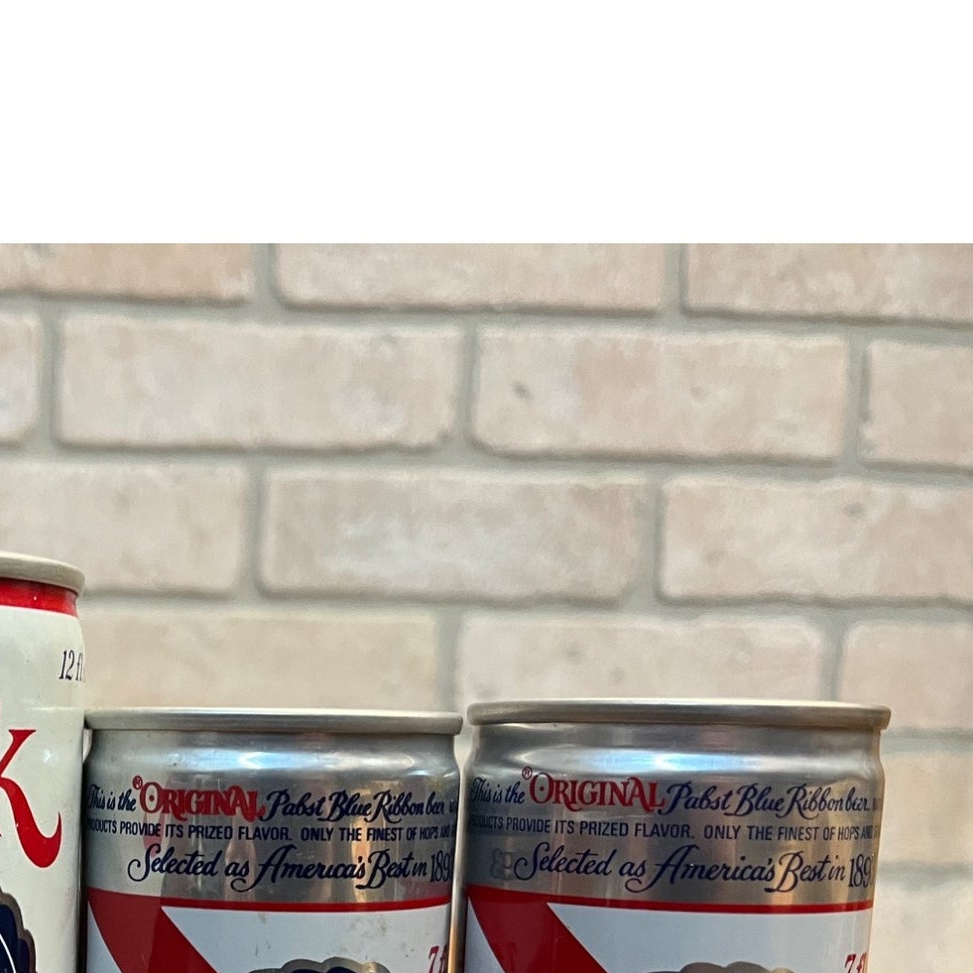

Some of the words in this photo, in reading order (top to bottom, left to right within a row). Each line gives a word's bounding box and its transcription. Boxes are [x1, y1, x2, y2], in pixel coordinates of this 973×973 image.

[58, 649, 75, 681] 12
[107, 791, 116, 811] is
[118, 788, 137, 812] the
[139, 781, 266, 823] ORIGINAL
[259, 788, 327, 822] Pabst
[317, 789, 372, 822] Blue
[364, 789, 425, 823] Ribbon
[471, 776, 491, 803] This
[492, 783, 502, 803] is
[504, 780, 526, 805] the
[529, 772, 666, 813] ORIGINAL
[657, 780, 734, 816] Pabst
[723, 782, 785, 817] Blue
[775, 783, 845, 820] Ribbon
[120, 822, 162, 837] PROVIDE
[165, 824, 184, 838] ITS
[188, 825, 233, 840] PRIZED
[238, 826, 292, 842] FLAVOR.
[300, 827, 334, 842] ONLY
[339, 827, 363, 842] THE
[366, 826, 403, 842] FINEST
[406, 826, 418, 840] OF
[420, 826, 439, 840] HOPS
[506, 818, 551, 833] PROVIDE
[555, 819, 575, 834] ITS
[579, 820, 629, 837] PRIZED
[634, 822, 695, 839] FLAVOR.
[703, 824, 741, 840] ONLY
[747, 825, 773, 841] THE
[777, 825, 819, 841] FINEST
[822, 826, 835, 841] OF
[837, 826, 860, 840] HOPS
[128, 843, 223, 882] Selected
[224, 860, 250, 878] as
[230, 844, 366, 893] America's
[355, 848, 414, 890] Best
[411, 859, 427, 879] in
[430, 851, 454, 883] 189
[513, 841, 617, 881] Selected
[618, 859, 646, 878] as
[624, 844, 776, 893] America's
[764, 849, 831, 893] Best
[828, 854, 846, 882] in
